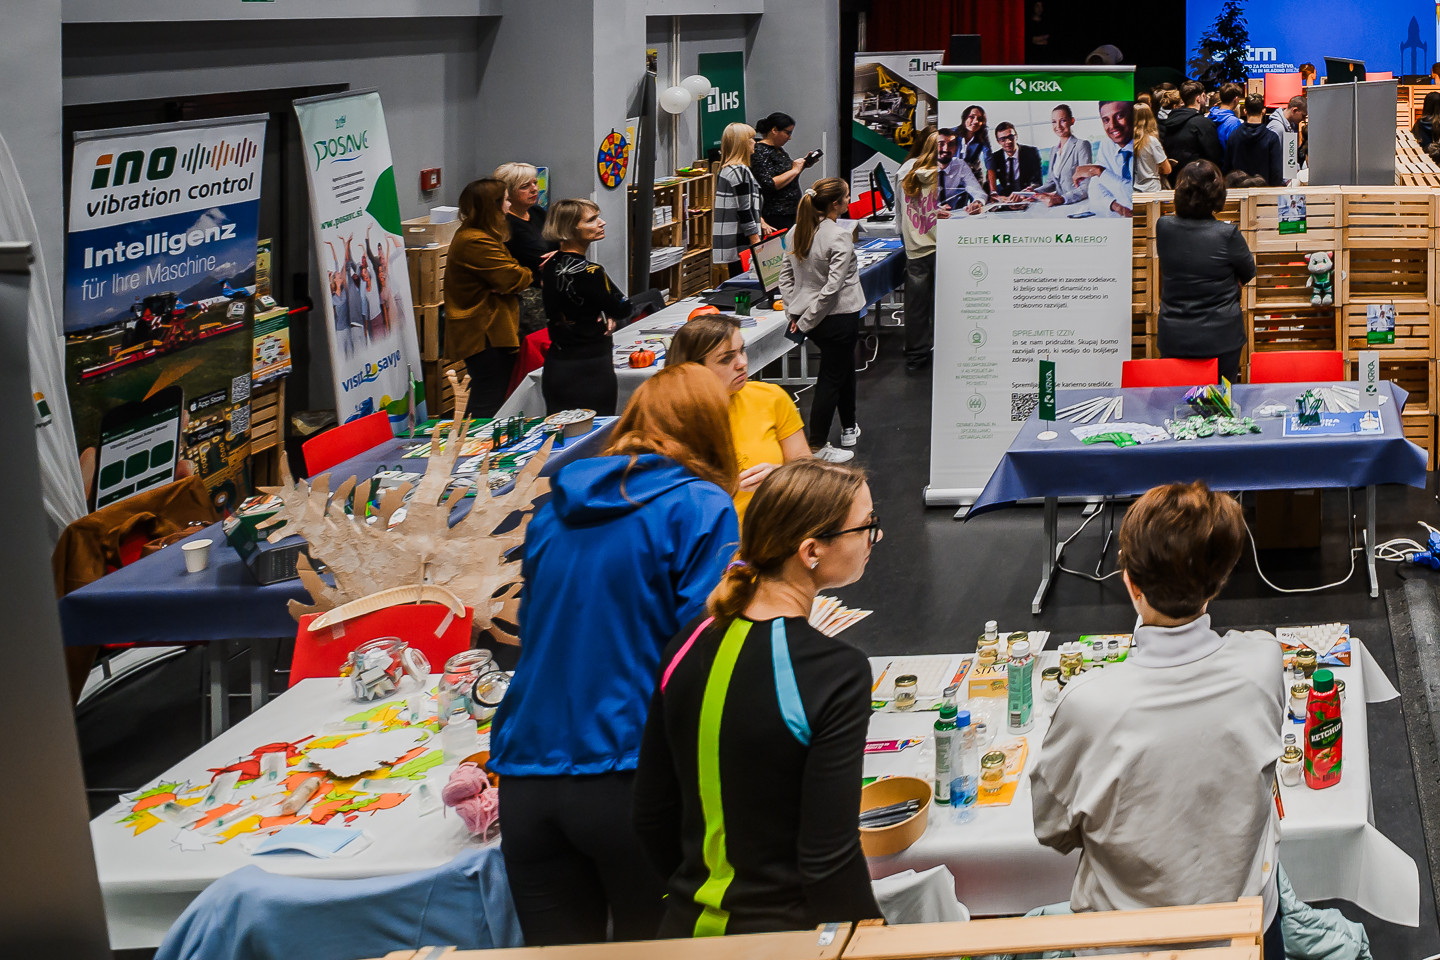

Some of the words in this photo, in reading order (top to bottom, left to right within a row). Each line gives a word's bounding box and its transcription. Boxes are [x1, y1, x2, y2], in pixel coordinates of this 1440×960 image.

[1029, 81, 1063, 92] KRKA
[721, 91, 740, 111] IHS
[90, 146, 178, 190] ino
[86, 187, 181, 218] vibration
[188, 172, 254, 200] control
[84, 223, 237, 269] Intelligenz
[958, 235, 989, 244] ŽELITE
[992, 234, 1052, 244] KREATIVNO
[1055, 233, 1108, 244] KARIERO?
[81, 278, 107, 301] für
[112, 272, 140, 294] Ihre
[145, 254, 216, 286] Maschine
[1045, 369, 1053, 394] KRKA
[1367, 360, 1375, 383] KRKA
[198, 400, 210, 409] App
[211, 393, 227, 405] Store
